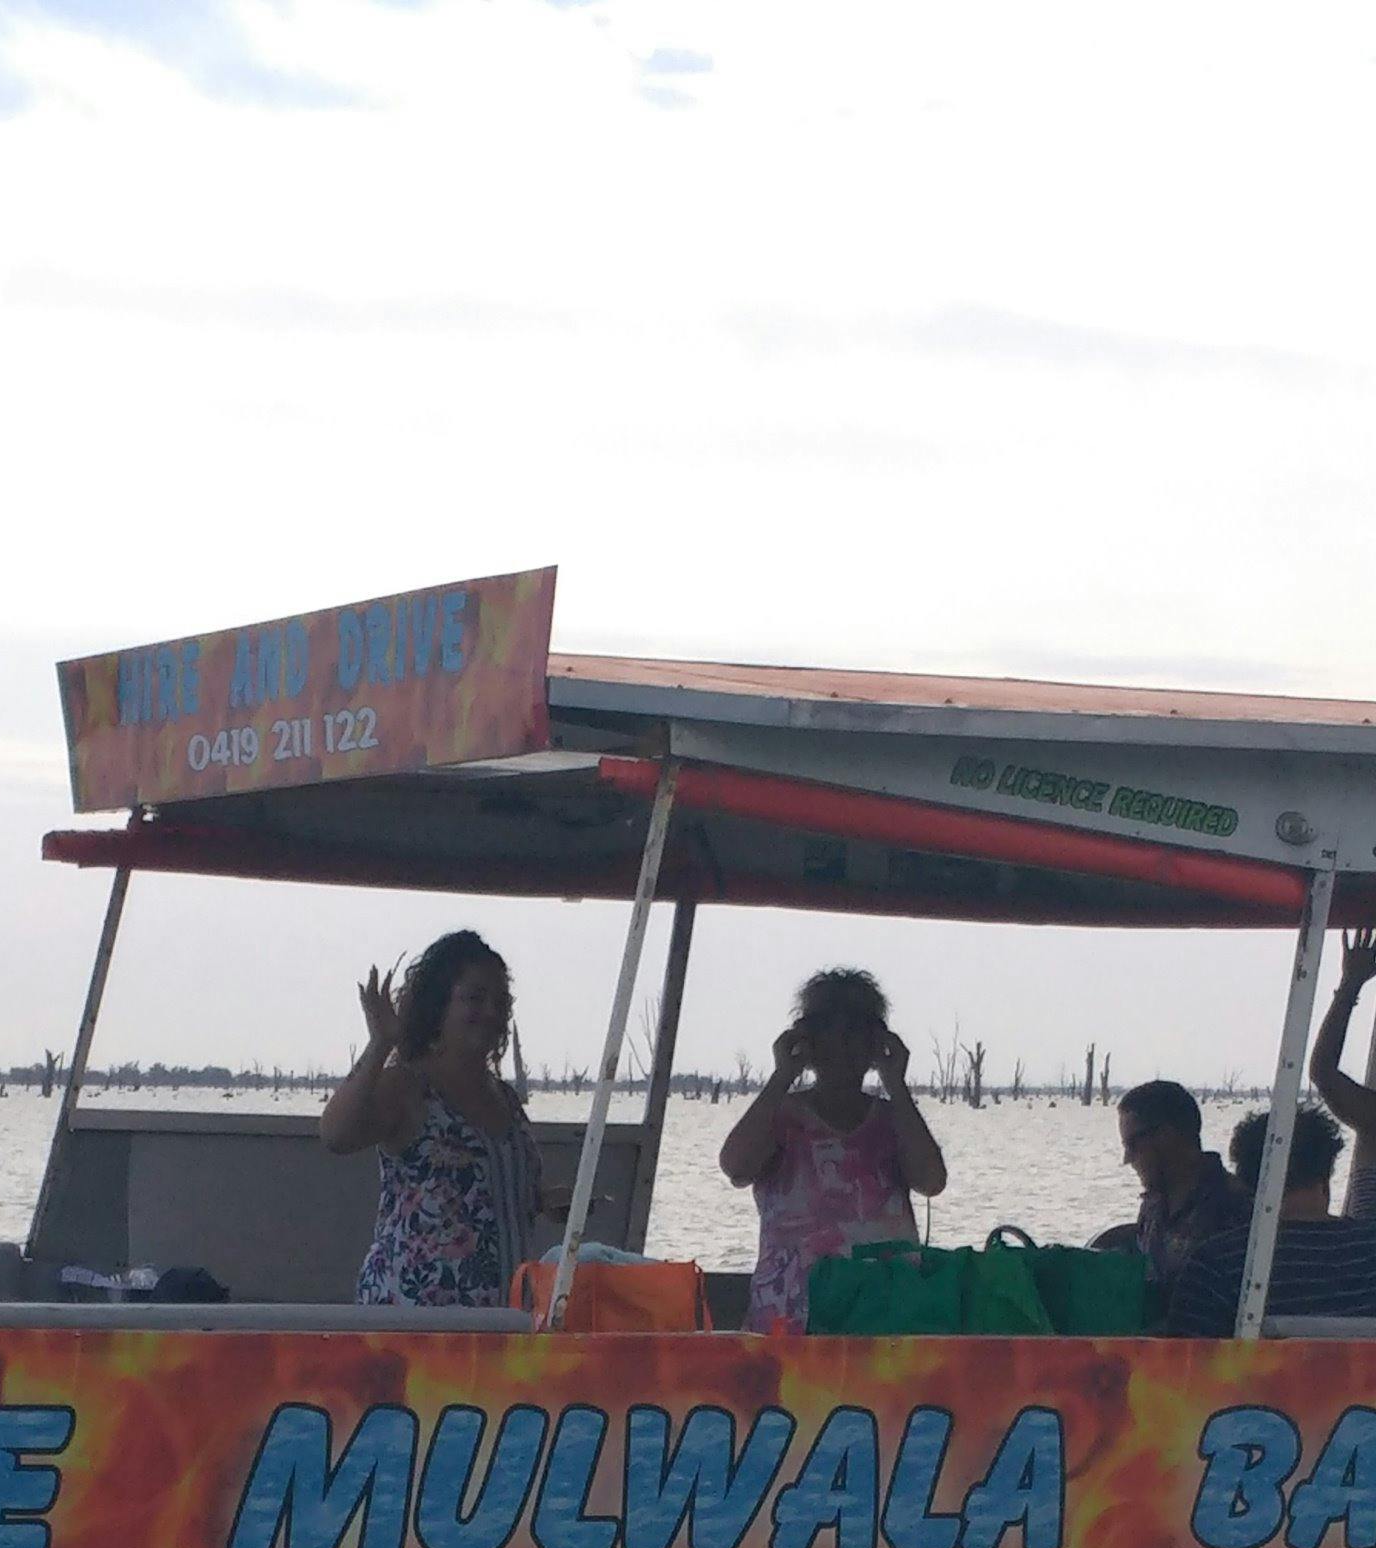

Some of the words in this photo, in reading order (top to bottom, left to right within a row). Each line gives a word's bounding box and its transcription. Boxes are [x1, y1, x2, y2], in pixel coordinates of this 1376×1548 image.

[116, 643, 201, 727] HIRE
[230, 620, 311, 708] AND
[337, 590, 469, 690] DRIVE
[187, 726, 260, 772] 0419
[272, 716, 312, 762] 211
[324, 707, 380, 753] 122
[949, 755, 997, 790] NO
[997, 765, 1111, 813] LICENCE
[1108, 786, 1240, 837] REQUIRED
